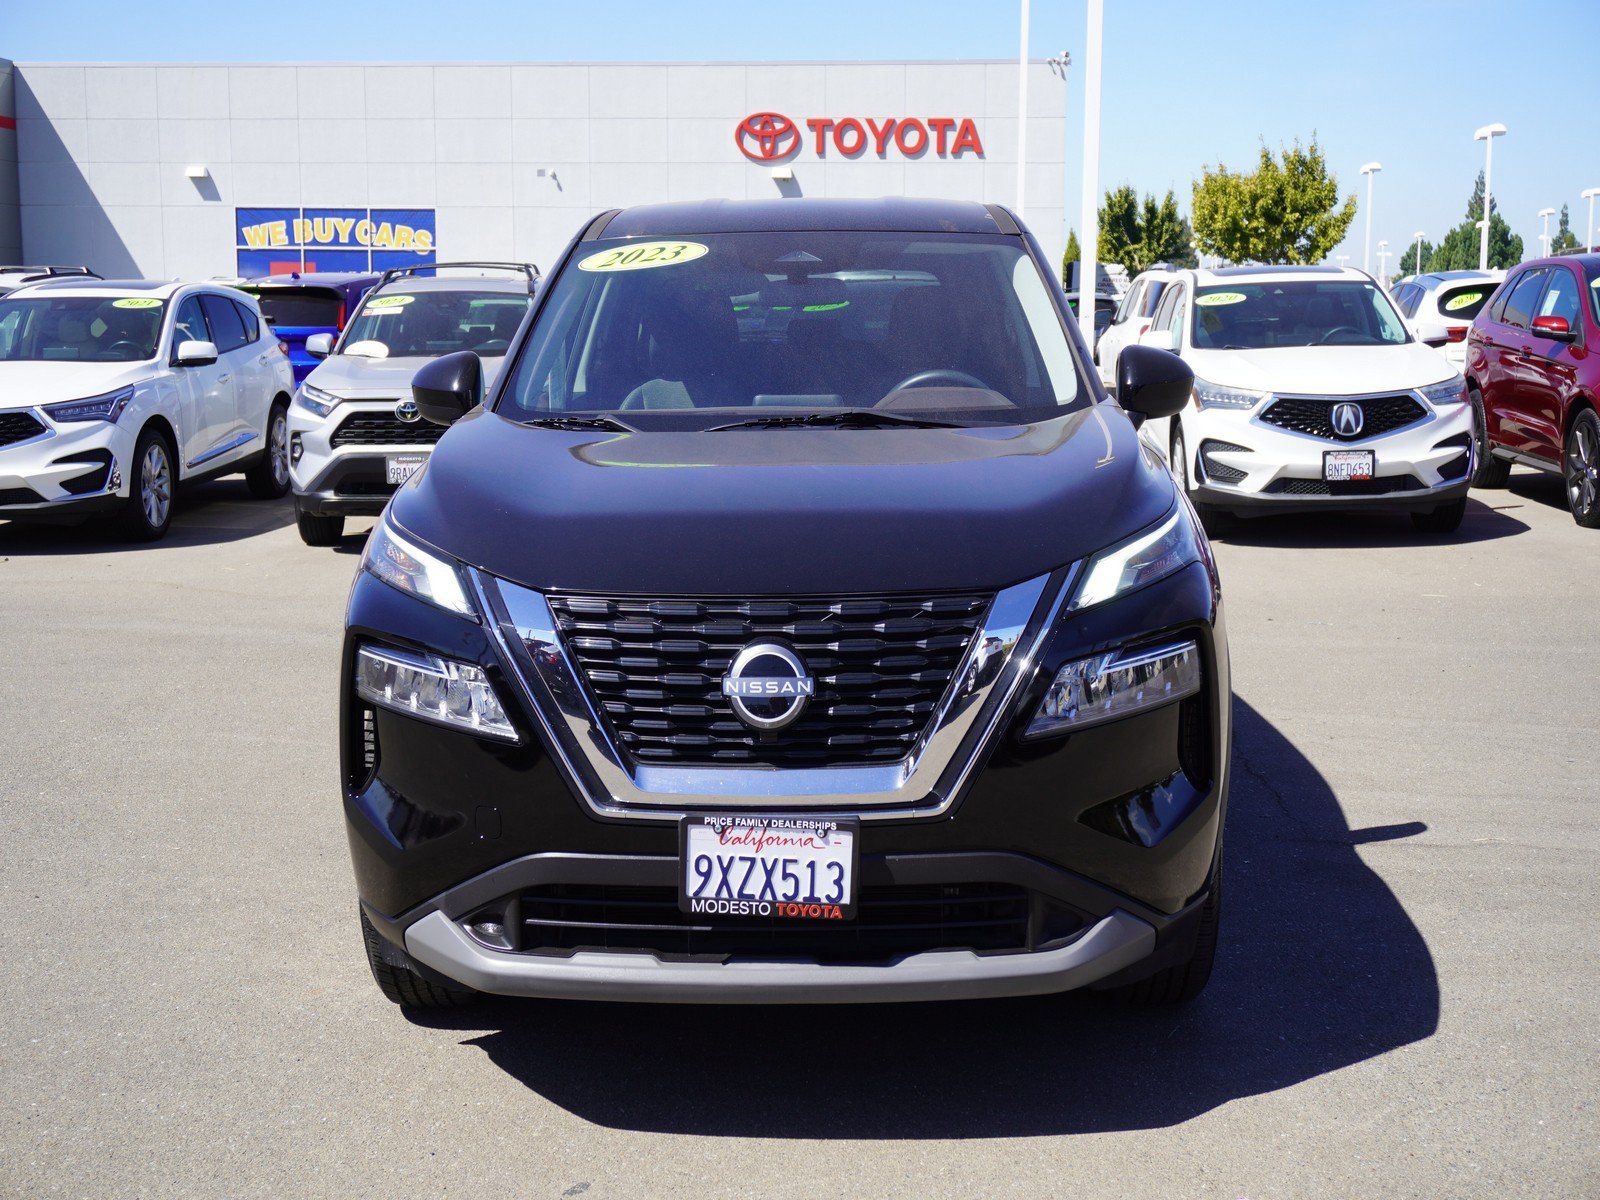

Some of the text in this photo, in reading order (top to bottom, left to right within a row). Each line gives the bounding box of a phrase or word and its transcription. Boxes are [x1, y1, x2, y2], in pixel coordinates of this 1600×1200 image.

[806, 117, 984, 156] TOYOTA
[242, 217, 433, 255] WE BUY CARS
[597, 245, 688, 268] 2023
[725, 680, 811, 694] NISSAN
[704, 816, 837, 831] PRICE FAMILY DEALERSHIPS
[719, 825, 826, 853] California
[692, 853, 845, 904] 9XZX513
[691, 899, 843, 919] MODESTO TOYOTA
